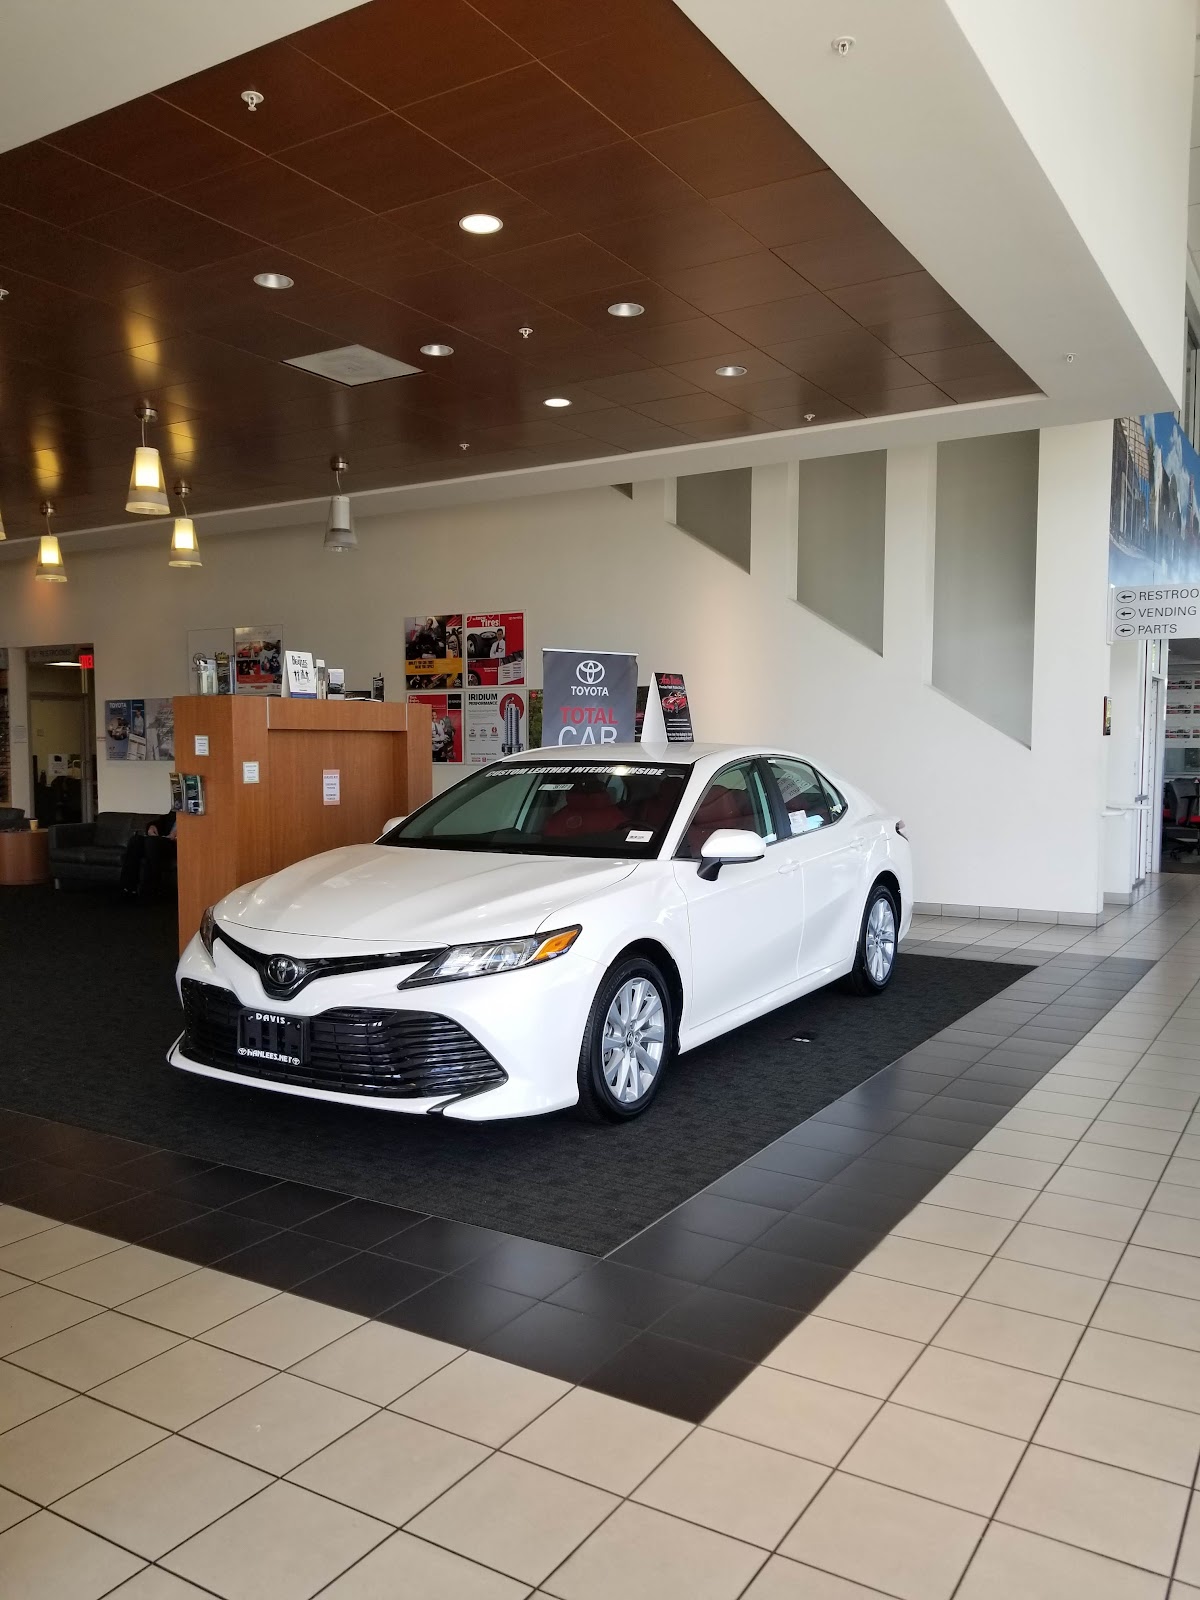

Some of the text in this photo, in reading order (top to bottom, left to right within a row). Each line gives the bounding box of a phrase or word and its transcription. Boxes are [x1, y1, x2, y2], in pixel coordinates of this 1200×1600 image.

[1138, 605, 1197, 618] VENDING
[481, 618, 499, 627] Tires
[1138, 623, 1178, 635] PARTS
[468, 693, 498, 701] IRIDIUM
[570, 685, 609, 697] TOYOTA
[560, 706, 618, 725] TOTAL
[558, 725, 618, 746] CAR
[485, 768, 530, 777] CUSTOM
[527, 766, 572, 774] LEATHER
[571, 766, 622, 774] INTERIO
[255, 1012, 286, 1025] DAVIS
